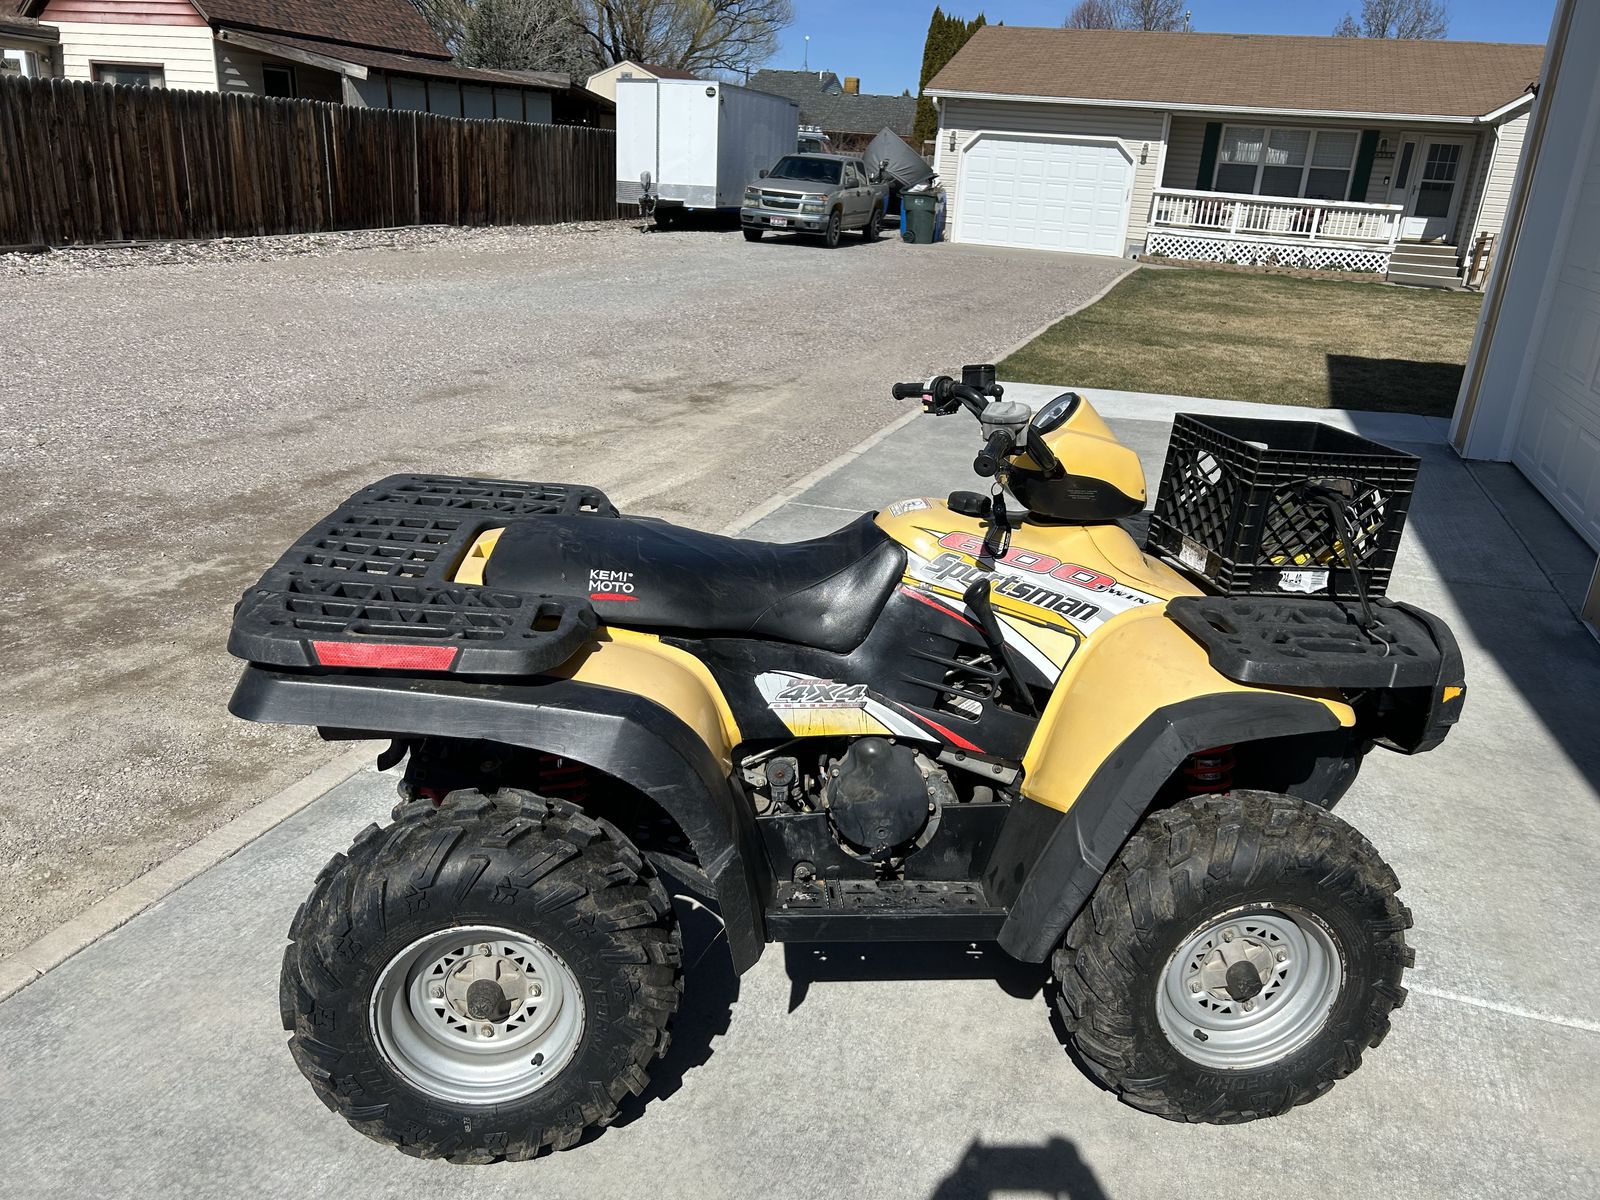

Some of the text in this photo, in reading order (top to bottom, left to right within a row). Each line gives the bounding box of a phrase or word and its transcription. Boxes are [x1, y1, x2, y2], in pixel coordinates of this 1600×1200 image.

[938, 531, 1117, 591] 600
[589, 569, 628, 582] KEMI
[588, 580, 635, 593] MOTO
